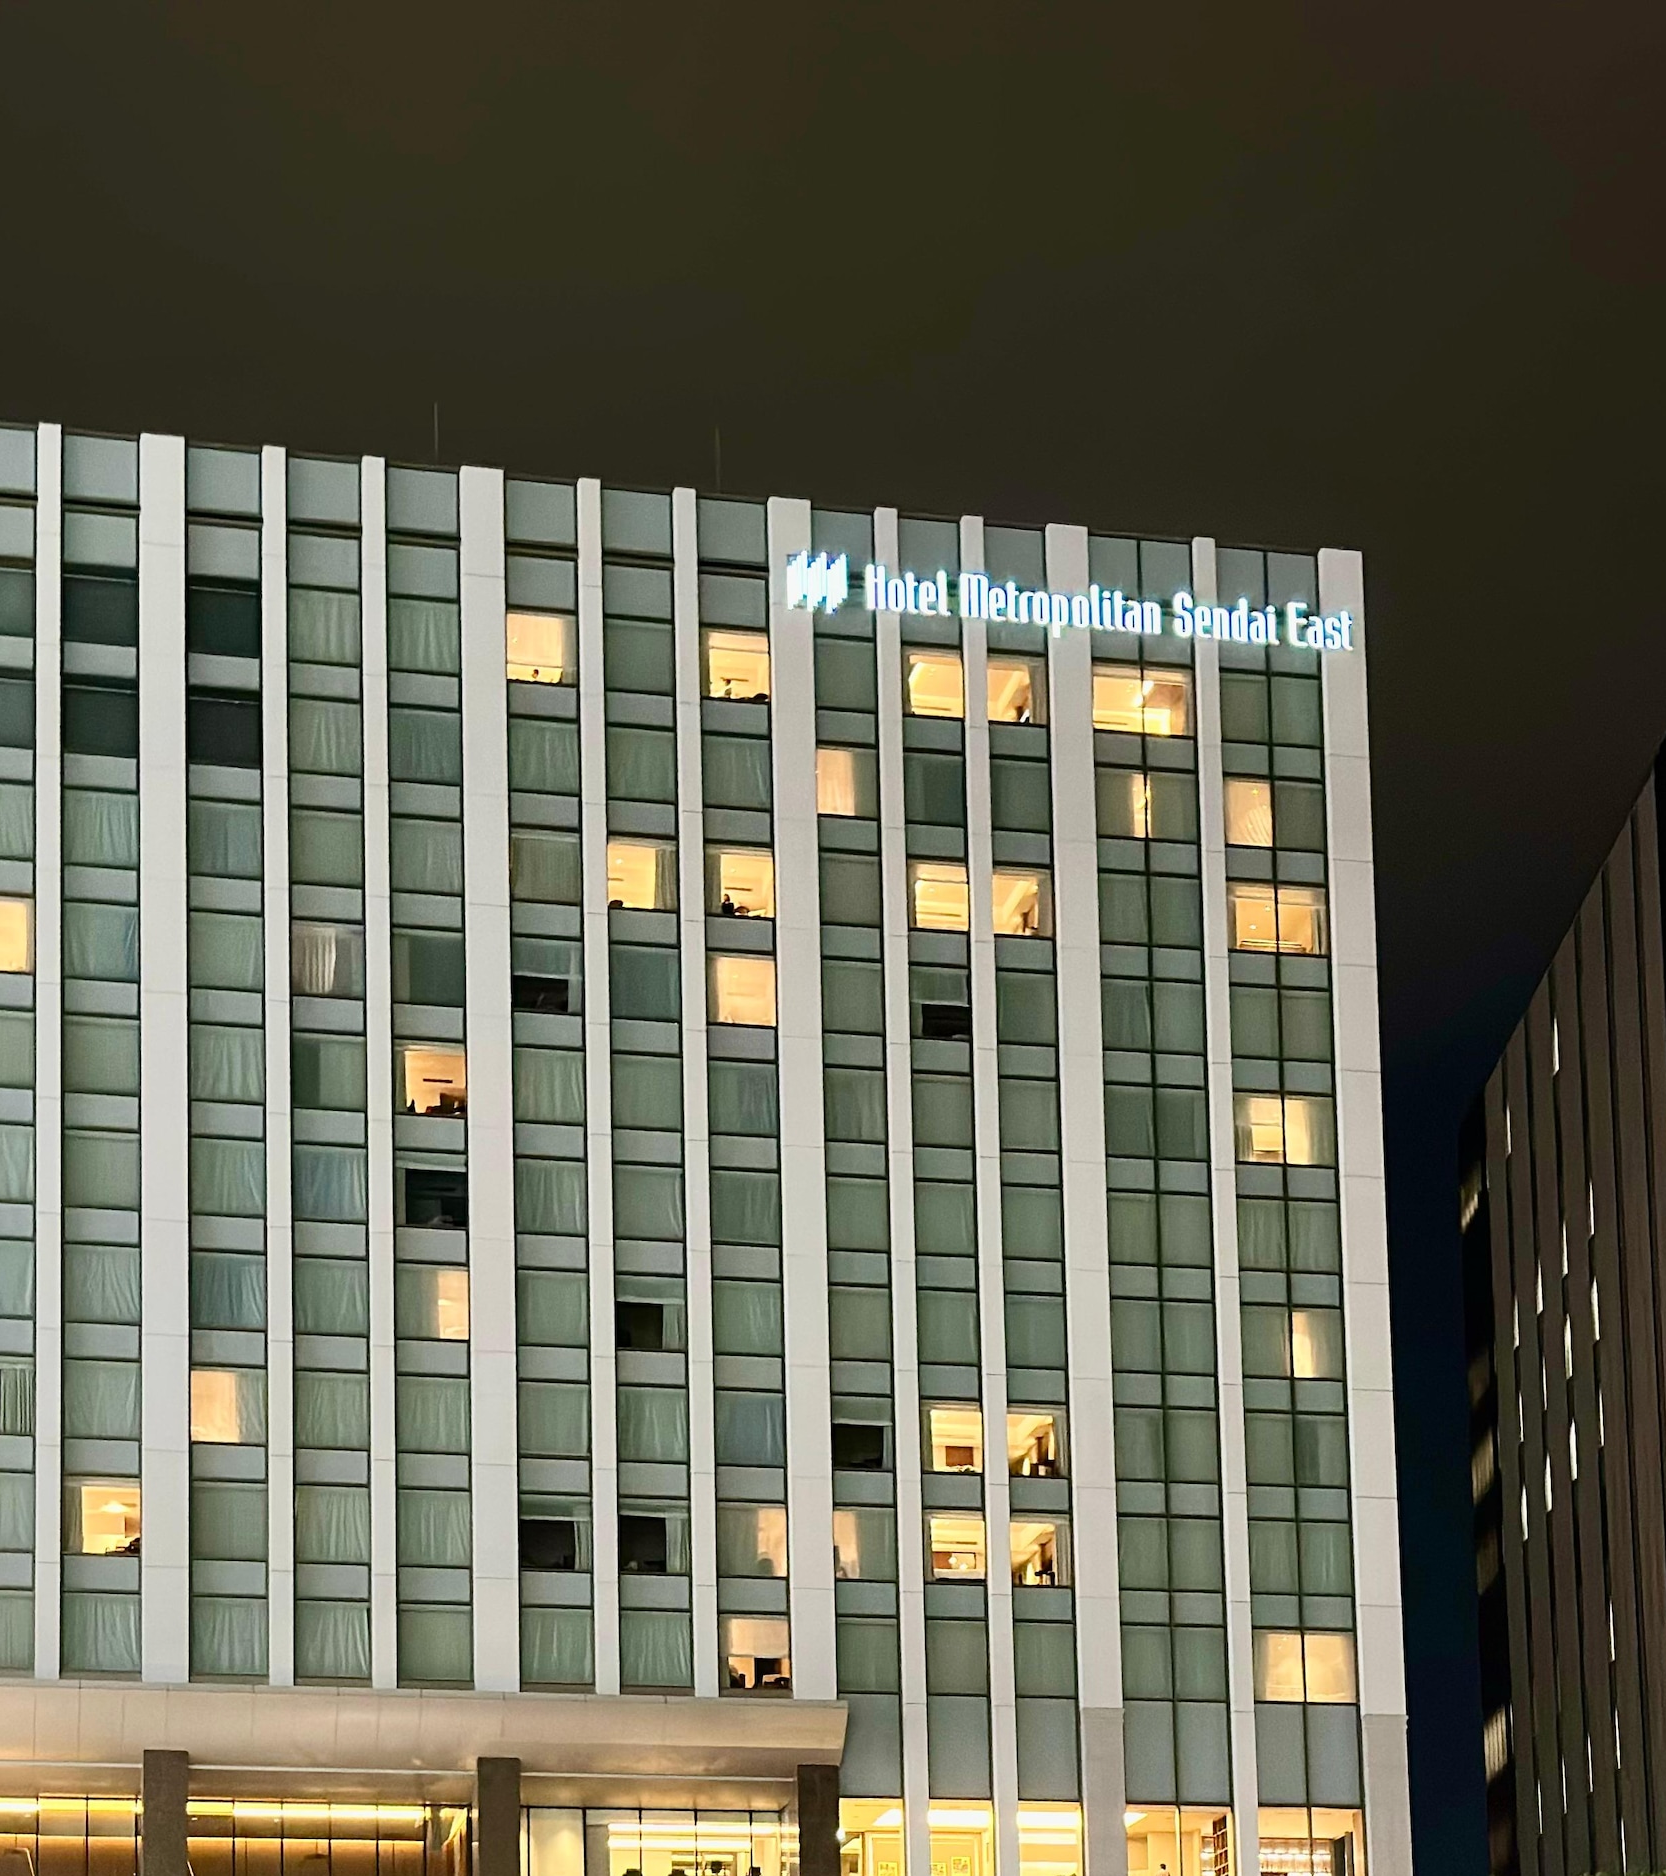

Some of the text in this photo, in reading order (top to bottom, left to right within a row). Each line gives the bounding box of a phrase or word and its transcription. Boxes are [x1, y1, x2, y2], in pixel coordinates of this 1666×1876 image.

[865, 563, 1354, 651] Hotel Metropolitan Sendai East
